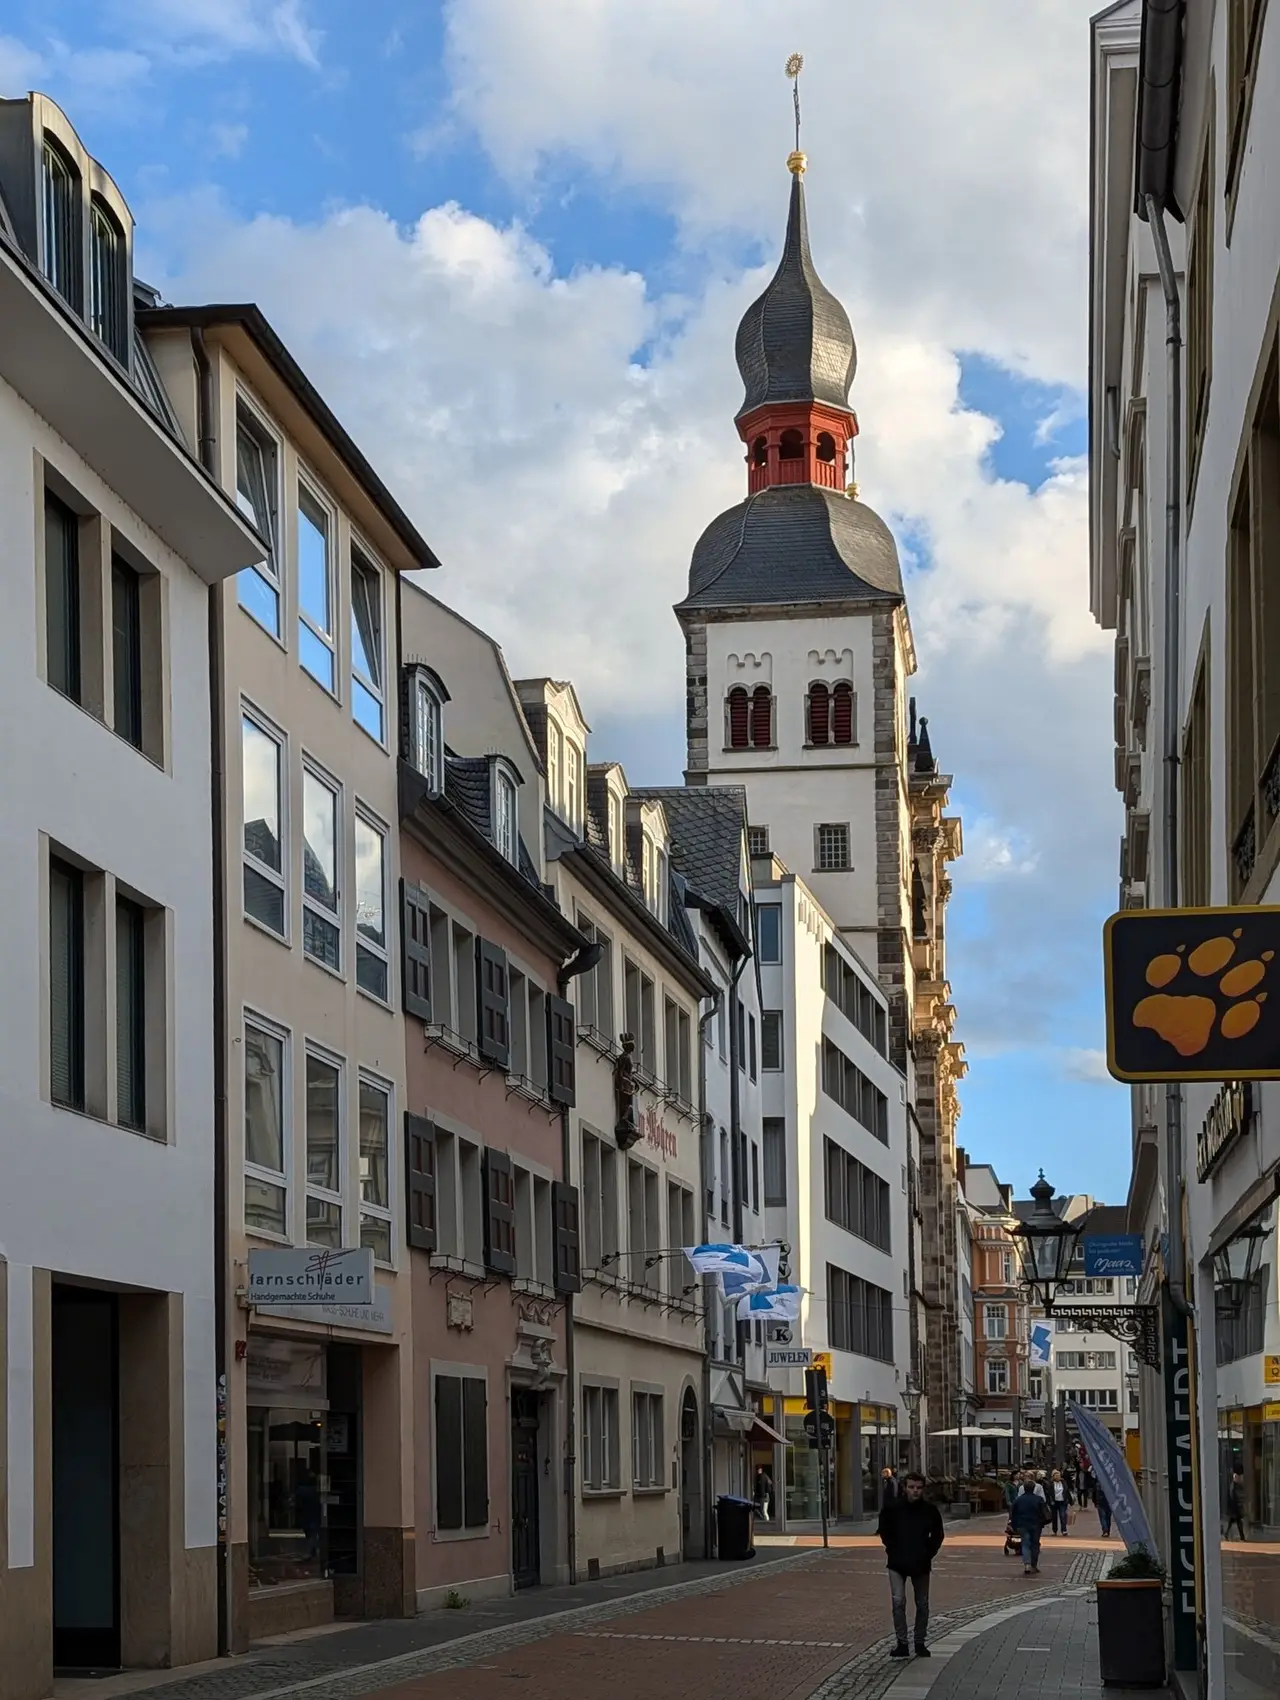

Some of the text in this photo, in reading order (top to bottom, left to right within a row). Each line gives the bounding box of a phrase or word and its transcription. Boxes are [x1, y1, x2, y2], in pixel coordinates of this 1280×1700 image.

[250, 1273, 364, 1286] farnschläder
[250, 1292, 336, 1302] Handgemachte Schuhe
[769, 1352, 809, 1363] JUWELEN
